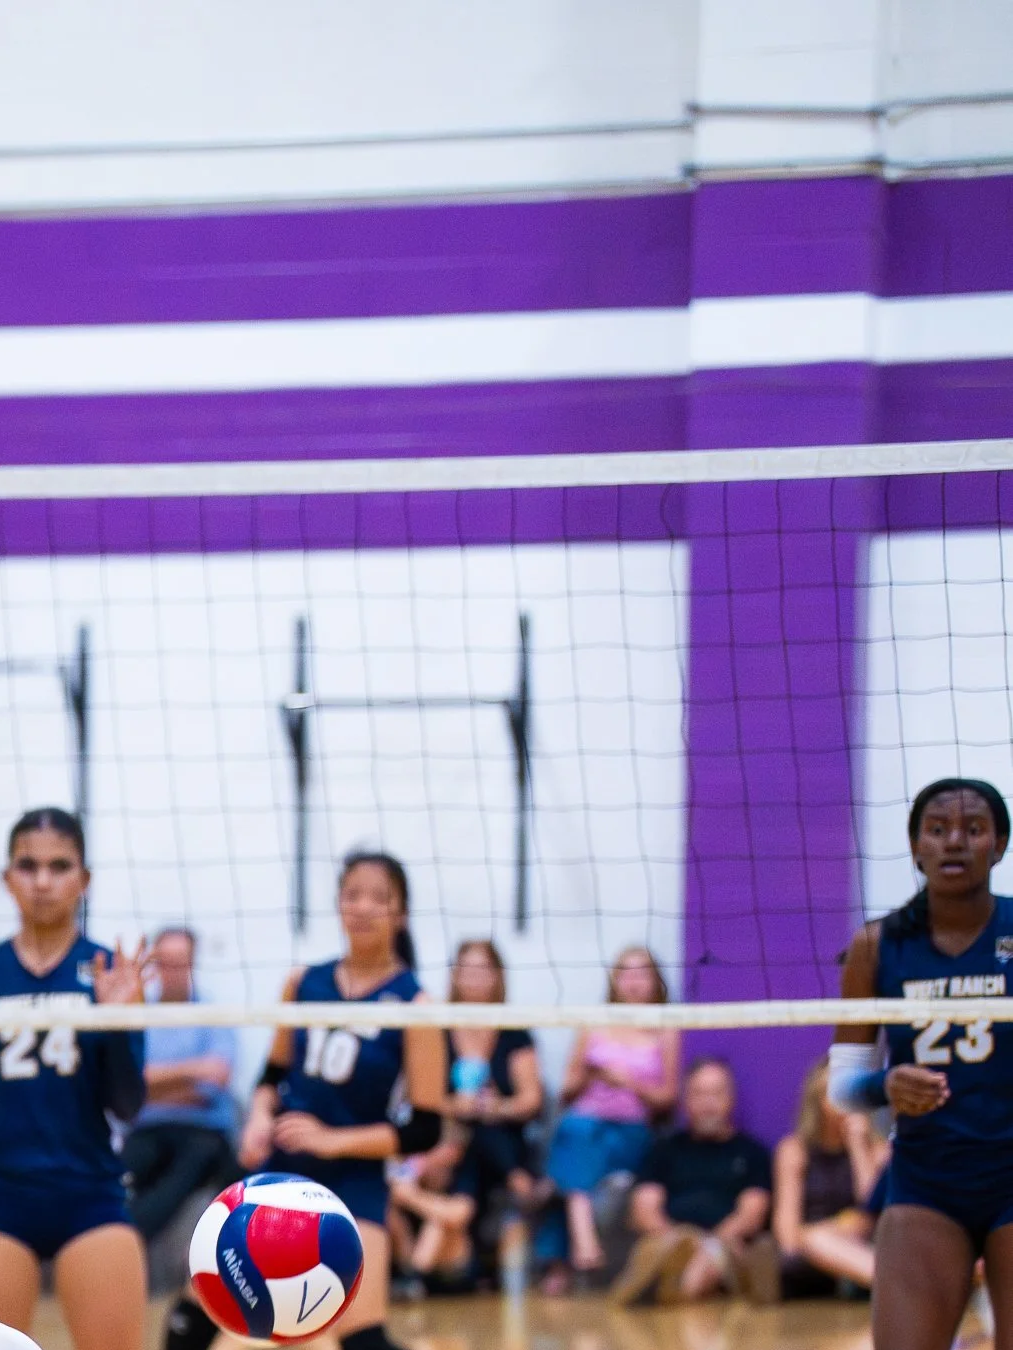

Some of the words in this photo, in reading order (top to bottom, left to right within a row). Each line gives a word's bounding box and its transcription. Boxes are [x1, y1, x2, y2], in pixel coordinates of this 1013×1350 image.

[949, 973, 1006, 998] RANCH
[0, 1025, 81, 1080] 24
[911, 1018, 995, 1065] 23
